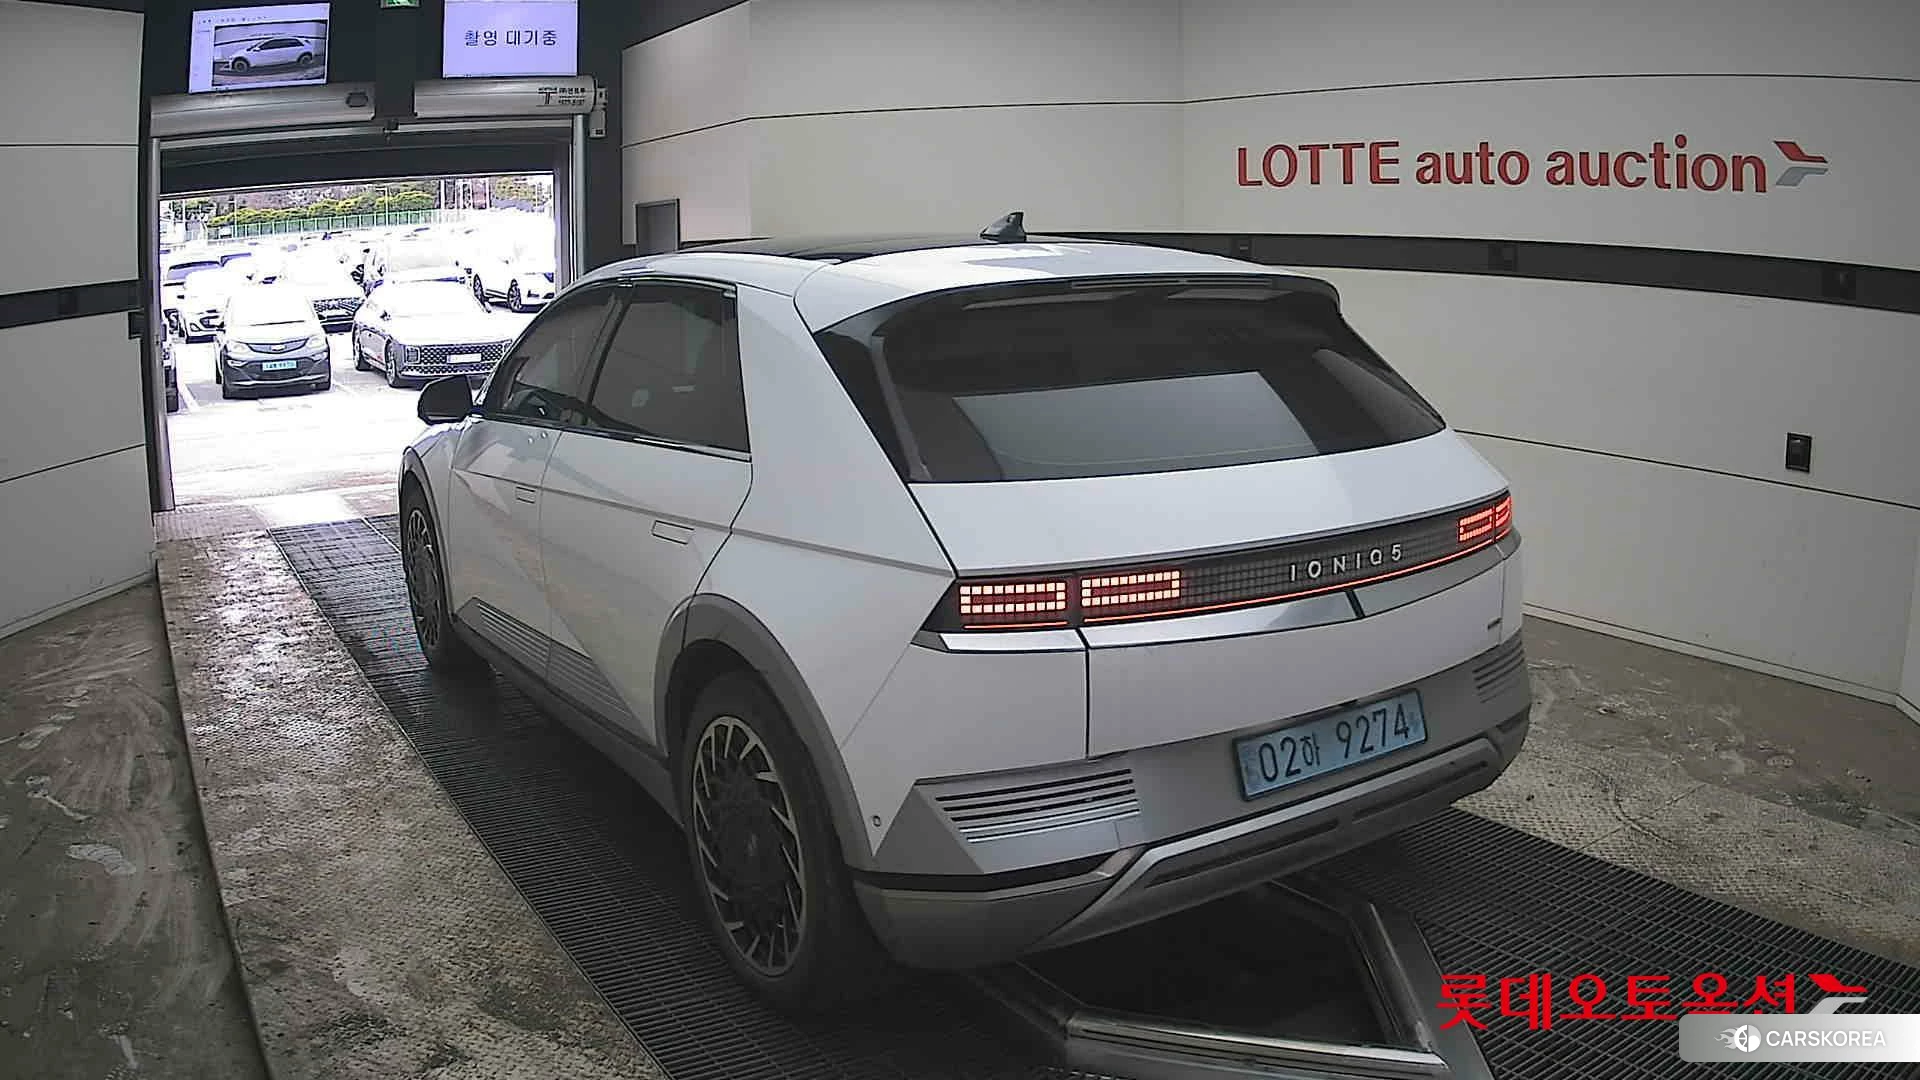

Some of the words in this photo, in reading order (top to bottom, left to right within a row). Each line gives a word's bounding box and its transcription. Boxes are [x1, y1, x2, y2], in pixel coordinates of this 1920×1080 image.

[465, 29, 498, 46] 촬영
[1238, 141, 1400, 187] LOTTE
[1416, 141, 1530, 185] auto
[1545, 134, 1767, 193] auction
[1336, 704, 1410, 759] 9274
